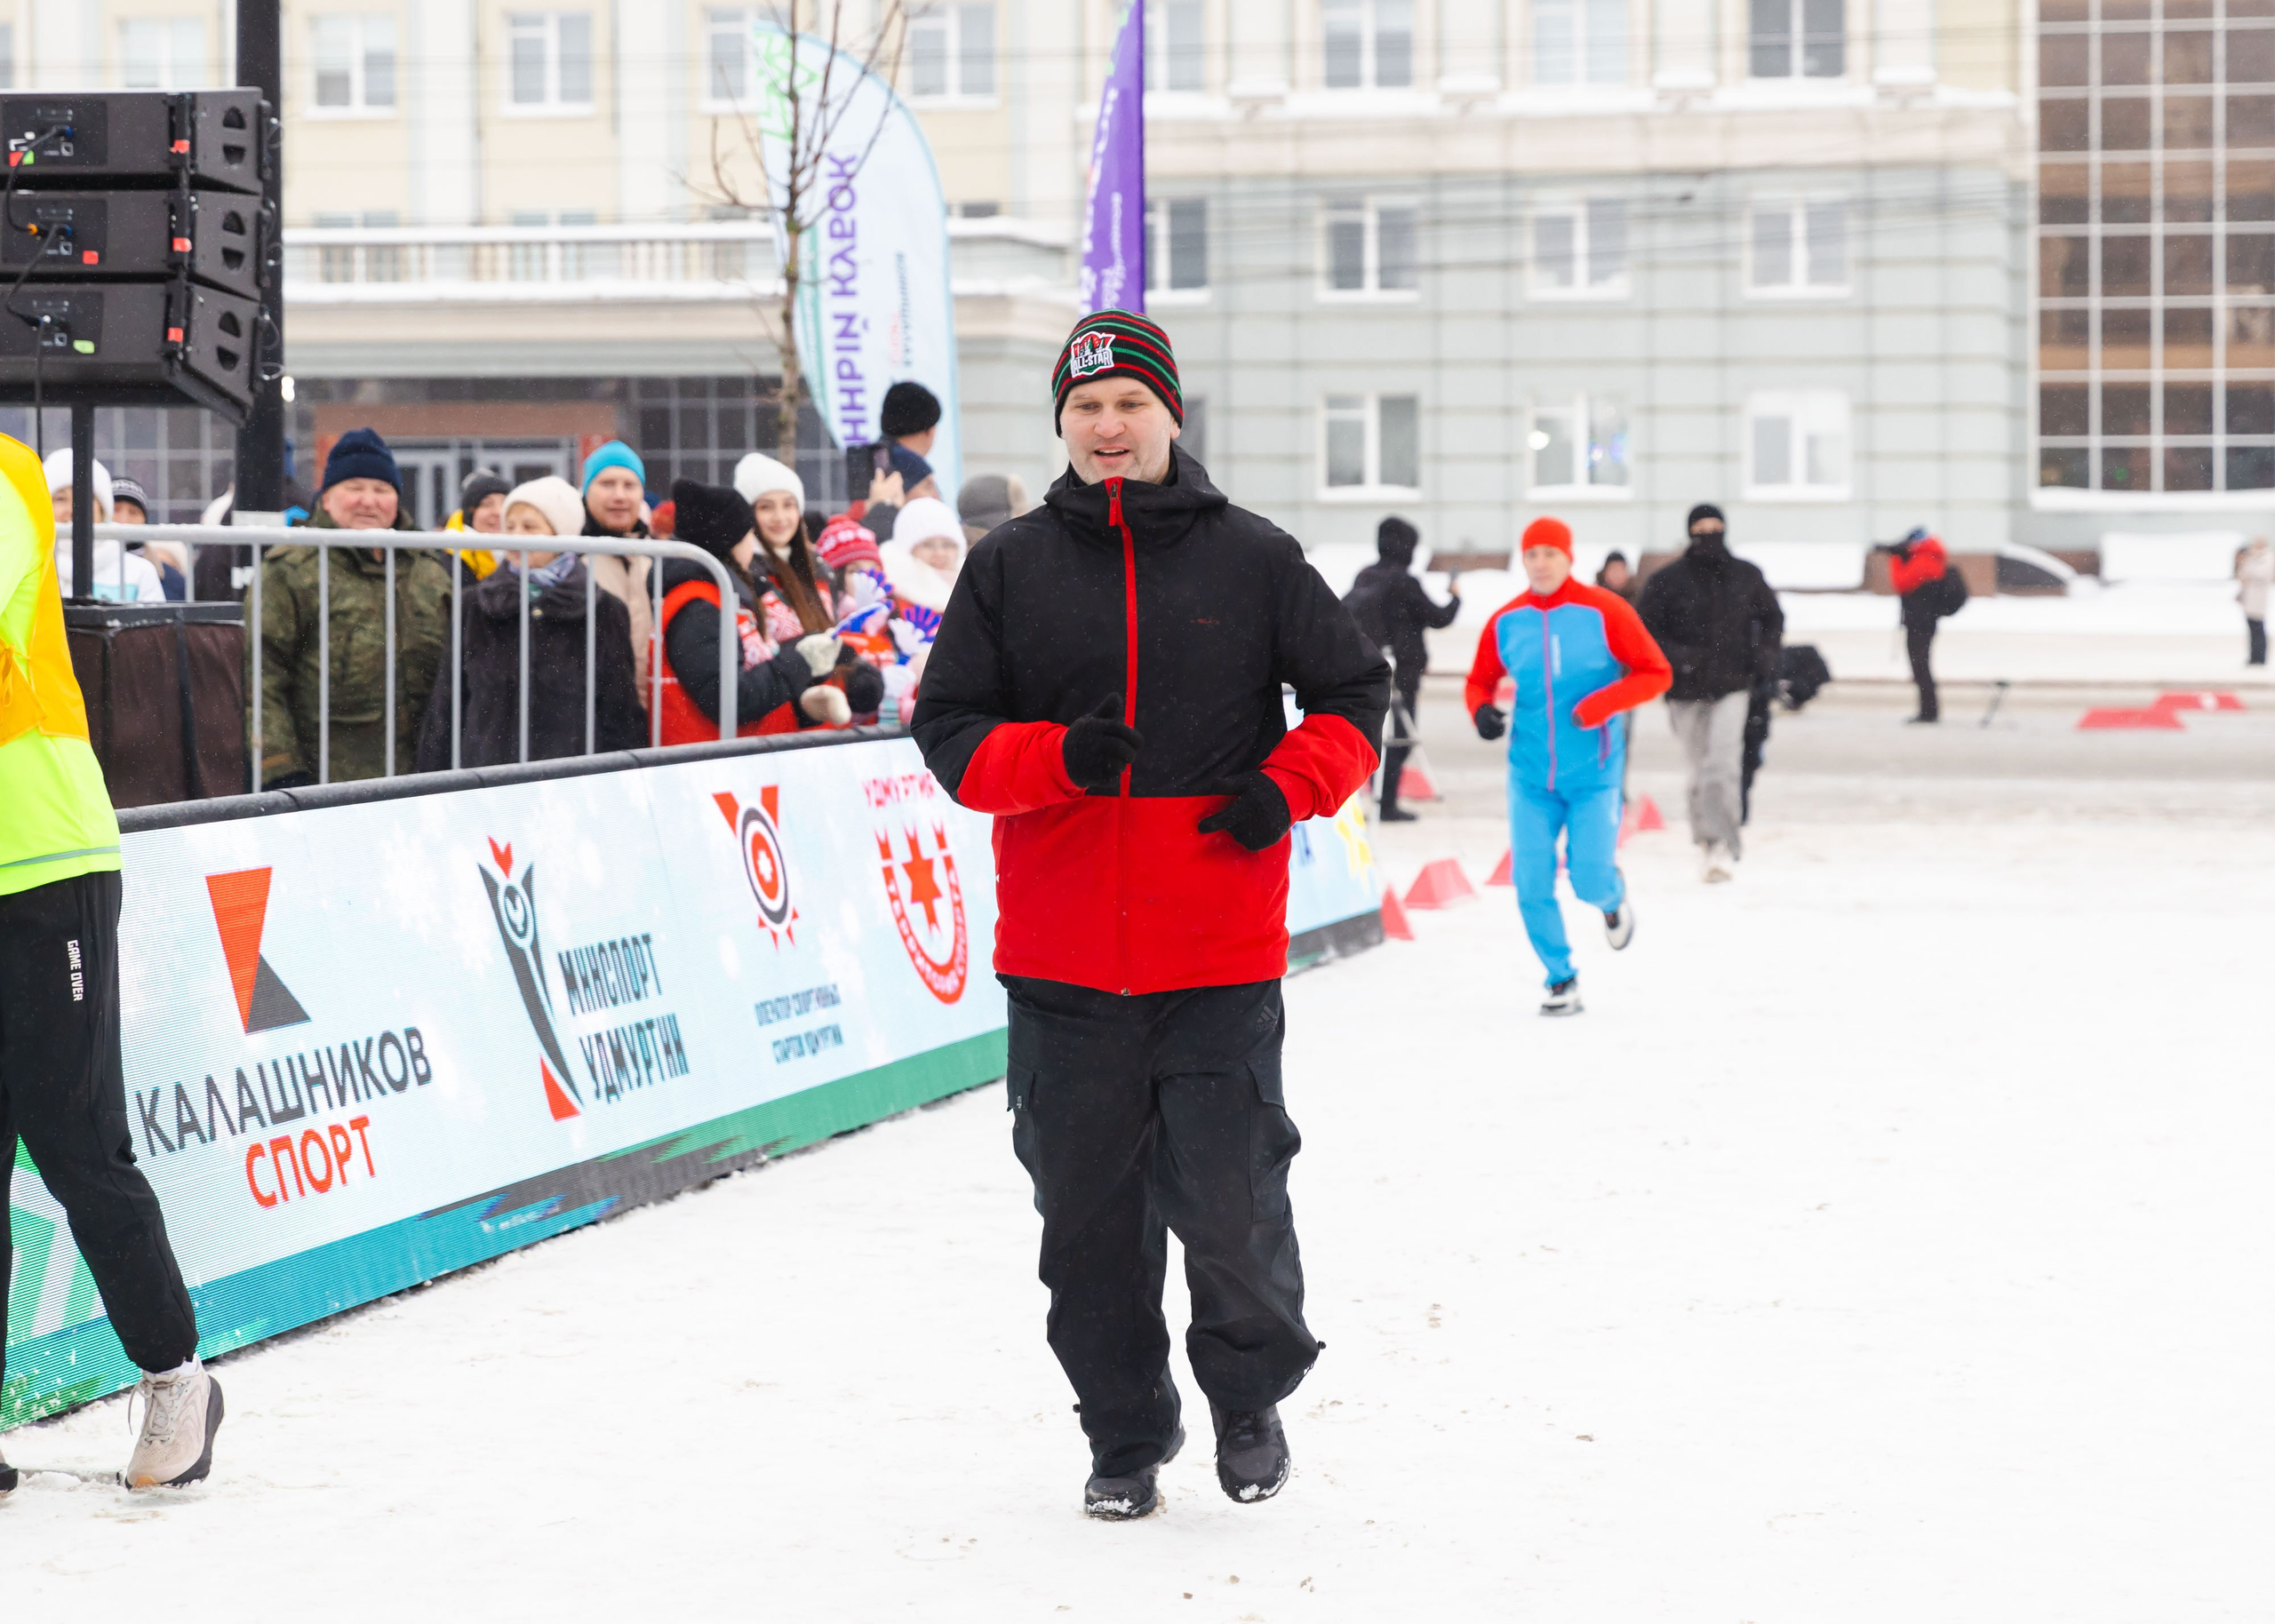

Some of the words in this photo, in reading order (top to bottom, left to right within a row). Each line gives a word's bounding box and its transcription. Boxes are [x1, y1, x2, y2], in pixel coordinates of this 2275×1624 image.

[1071, 352, 1111, 376] ALL-STAR
[67, 939, 82, 971] GAME
[70, 972, 84, 1002] OVER
[557, 933, 663, 1016] МИНСПОРТ
[135, 1026, 432, 1157] КАЛАШНИКОВ
[579, 1013, 690, 1104] УДМУРТИИ
[245, 1114, 376, 1209] СПОРТ
